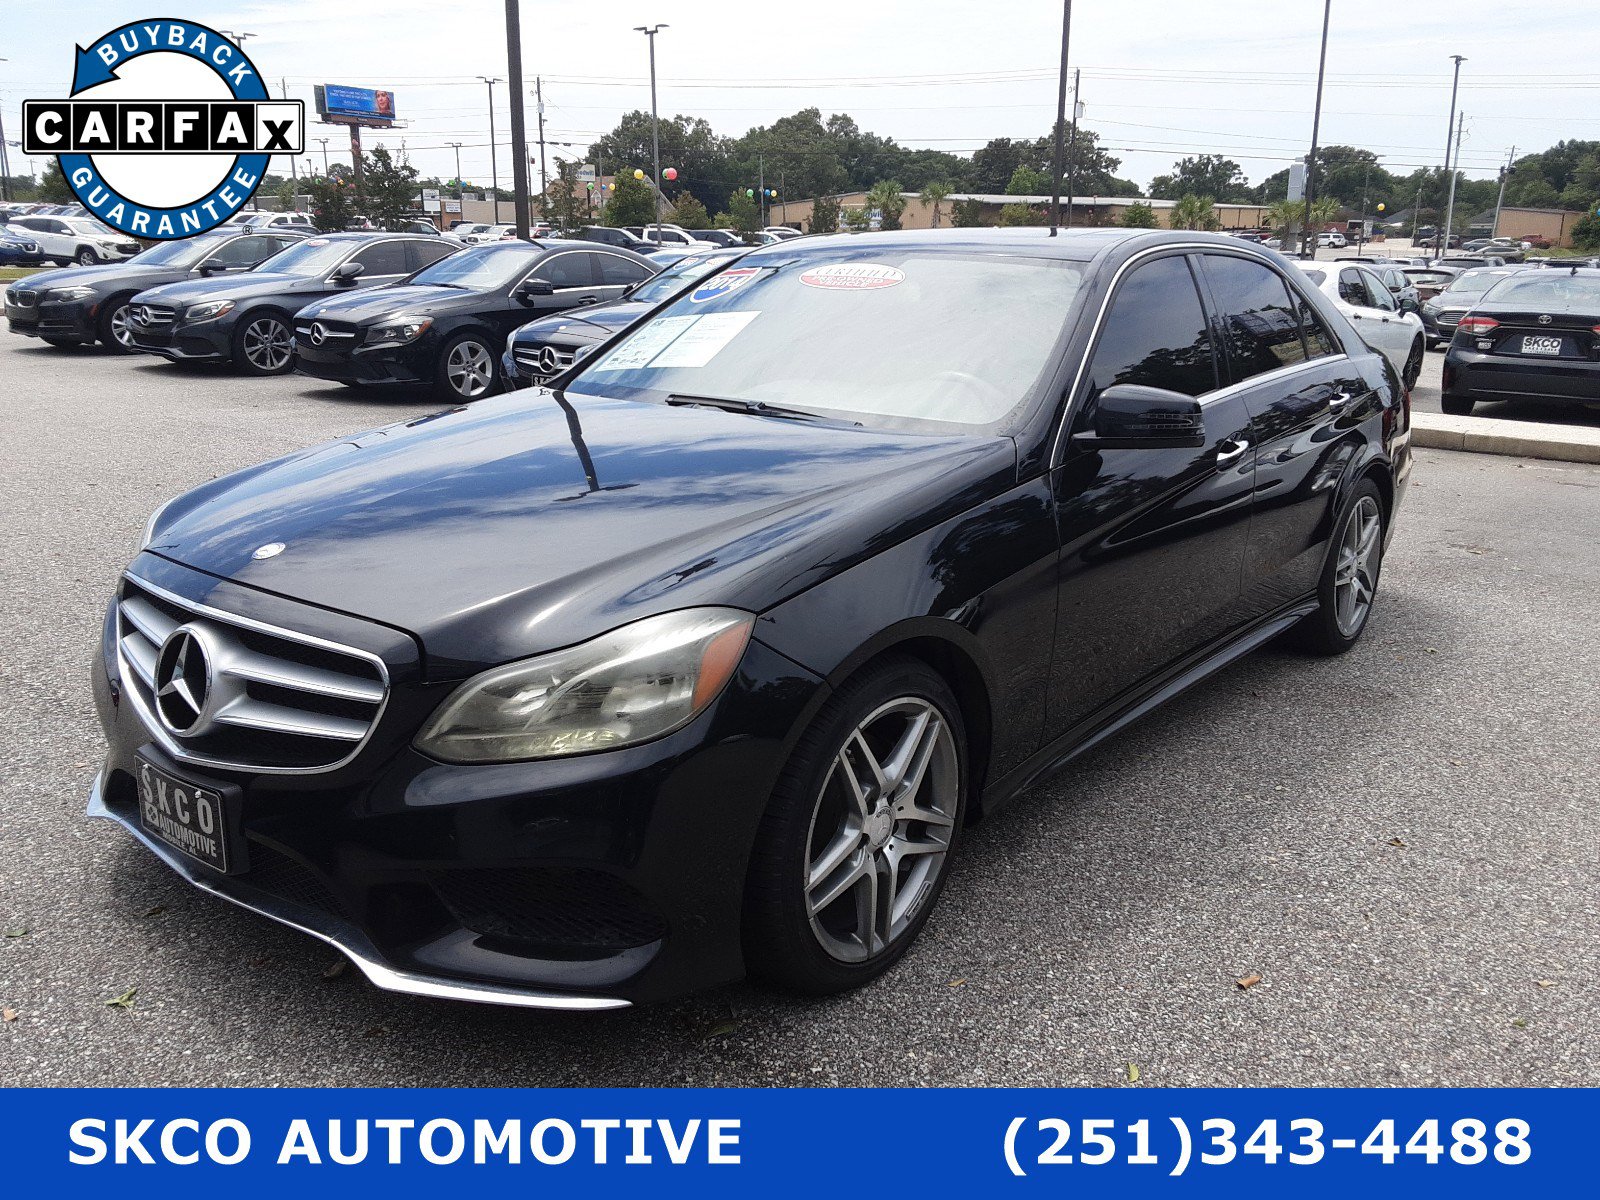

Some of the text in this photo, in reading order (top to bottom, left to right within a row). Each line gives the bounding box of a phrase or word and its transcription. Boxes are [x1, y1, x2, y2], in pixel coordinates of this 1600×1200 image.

[700, 275, 750, 291] 2014
[1524, 337, 1560, 348] SKCO
[141, 768, 214, 834] SKCO
[160, 814, 217, 858] AUTOMOTIVE
